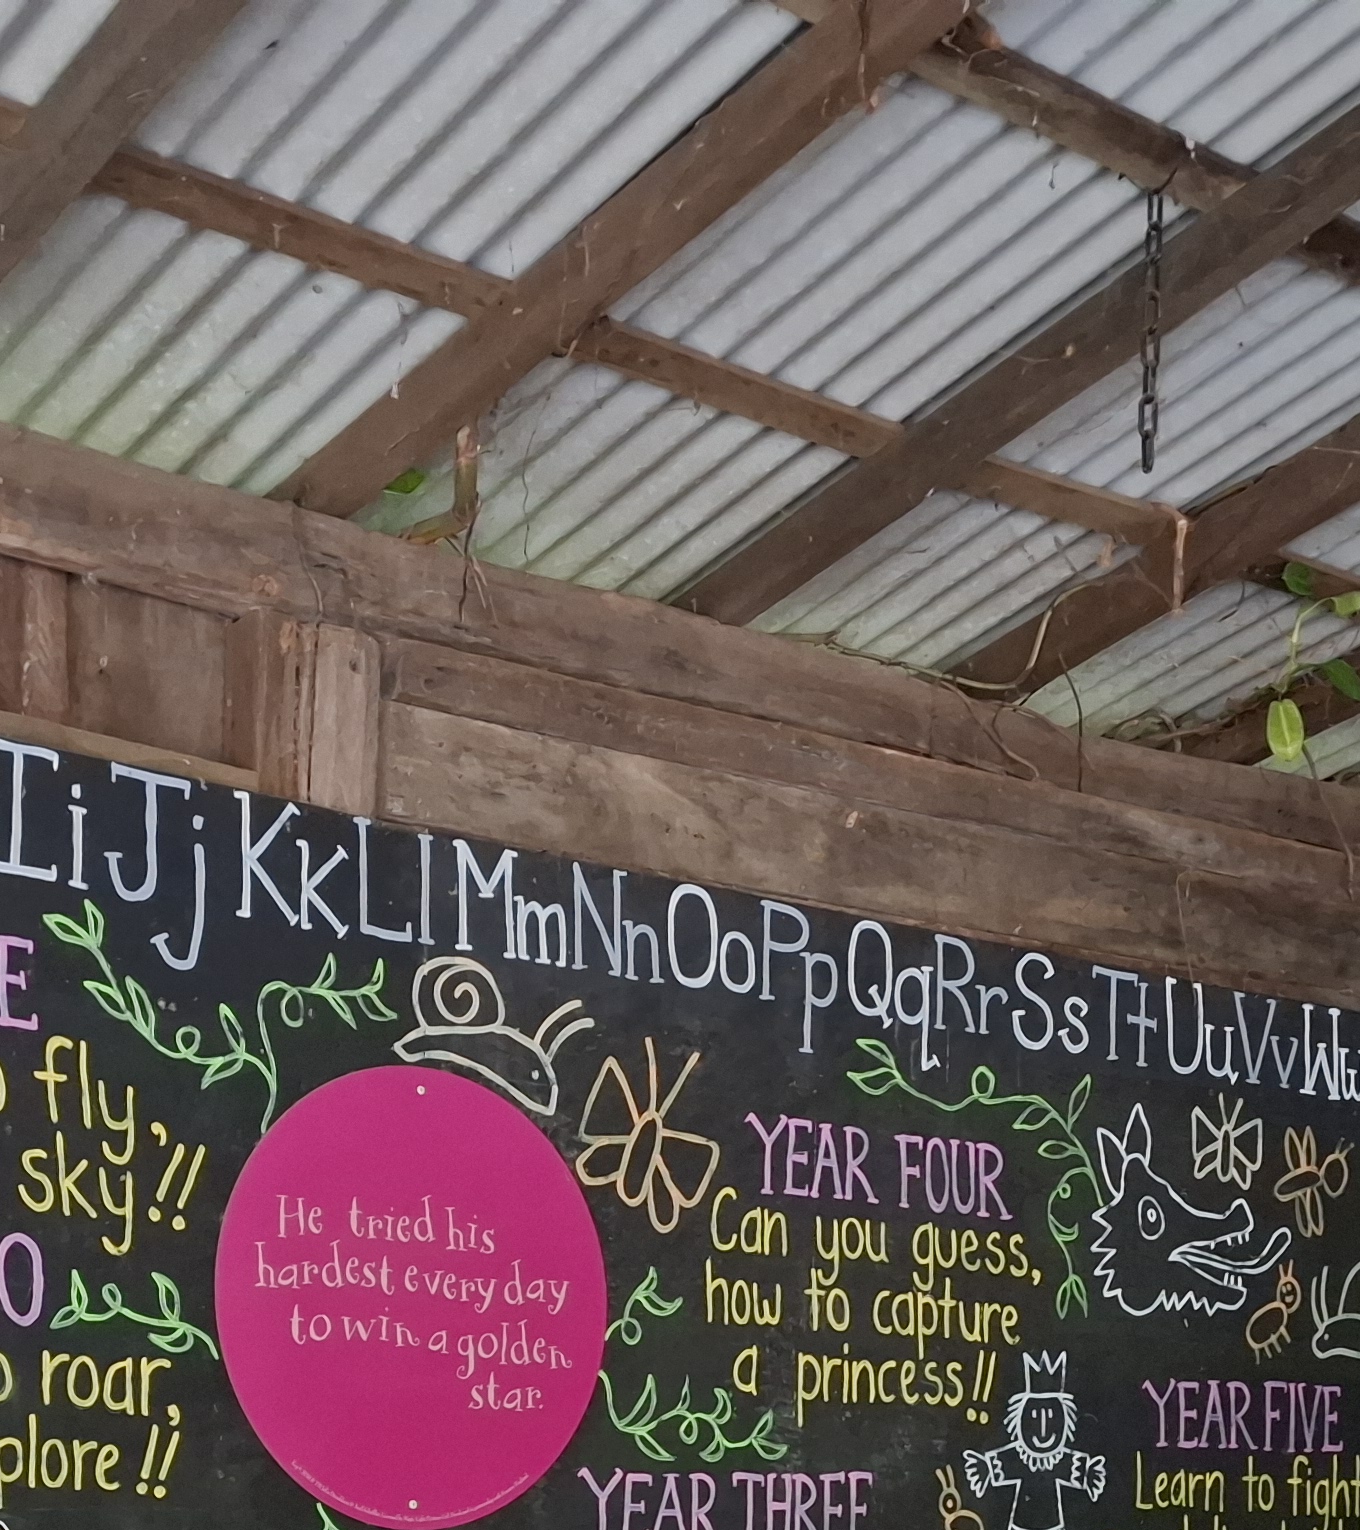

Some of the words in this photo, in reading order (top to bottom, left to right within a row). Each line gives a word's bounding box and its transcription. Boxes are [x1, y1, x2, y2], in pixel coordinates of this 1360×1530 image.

[744, 1112, 880, 1204] YEAR
[894, 1134, 1013, 1220] FOUR
[276, 1194, 323, 1238] He
[348, 1194, 436, 1243] tried
[445, 1207, 495, 1254] his
[710, 1187, 788, 1257] Can
[816, 1215, 889, 1286] you
[912, 1221, 1042, 1291] guess,
[254, 1240, 395, 1295] hardest
[404, 1265, 497, 1313] every
[504, 1259, 570, 1315] day
[706, 1257, 781, 1325] how
[804, 1268, 850, 1332] to
[873, 1278, 1021, 1360] capture
[290, 1304, 332, 1345] to
[342, 1307, 420, 1348] win
[428, 1330, 449, 1354] a
[456, 1319, 572, 1379] golden
[733, 1345, 757, 1396] a
[468, 1372, 544, 1412] star.
[1142, 1378, 1258, 1449] YEAR
[1263, 1380, 1344, 1453] FIVE
[1136, 1451, 1224, 1512] Learn
[1242, 1455, 1275, 1512] to
